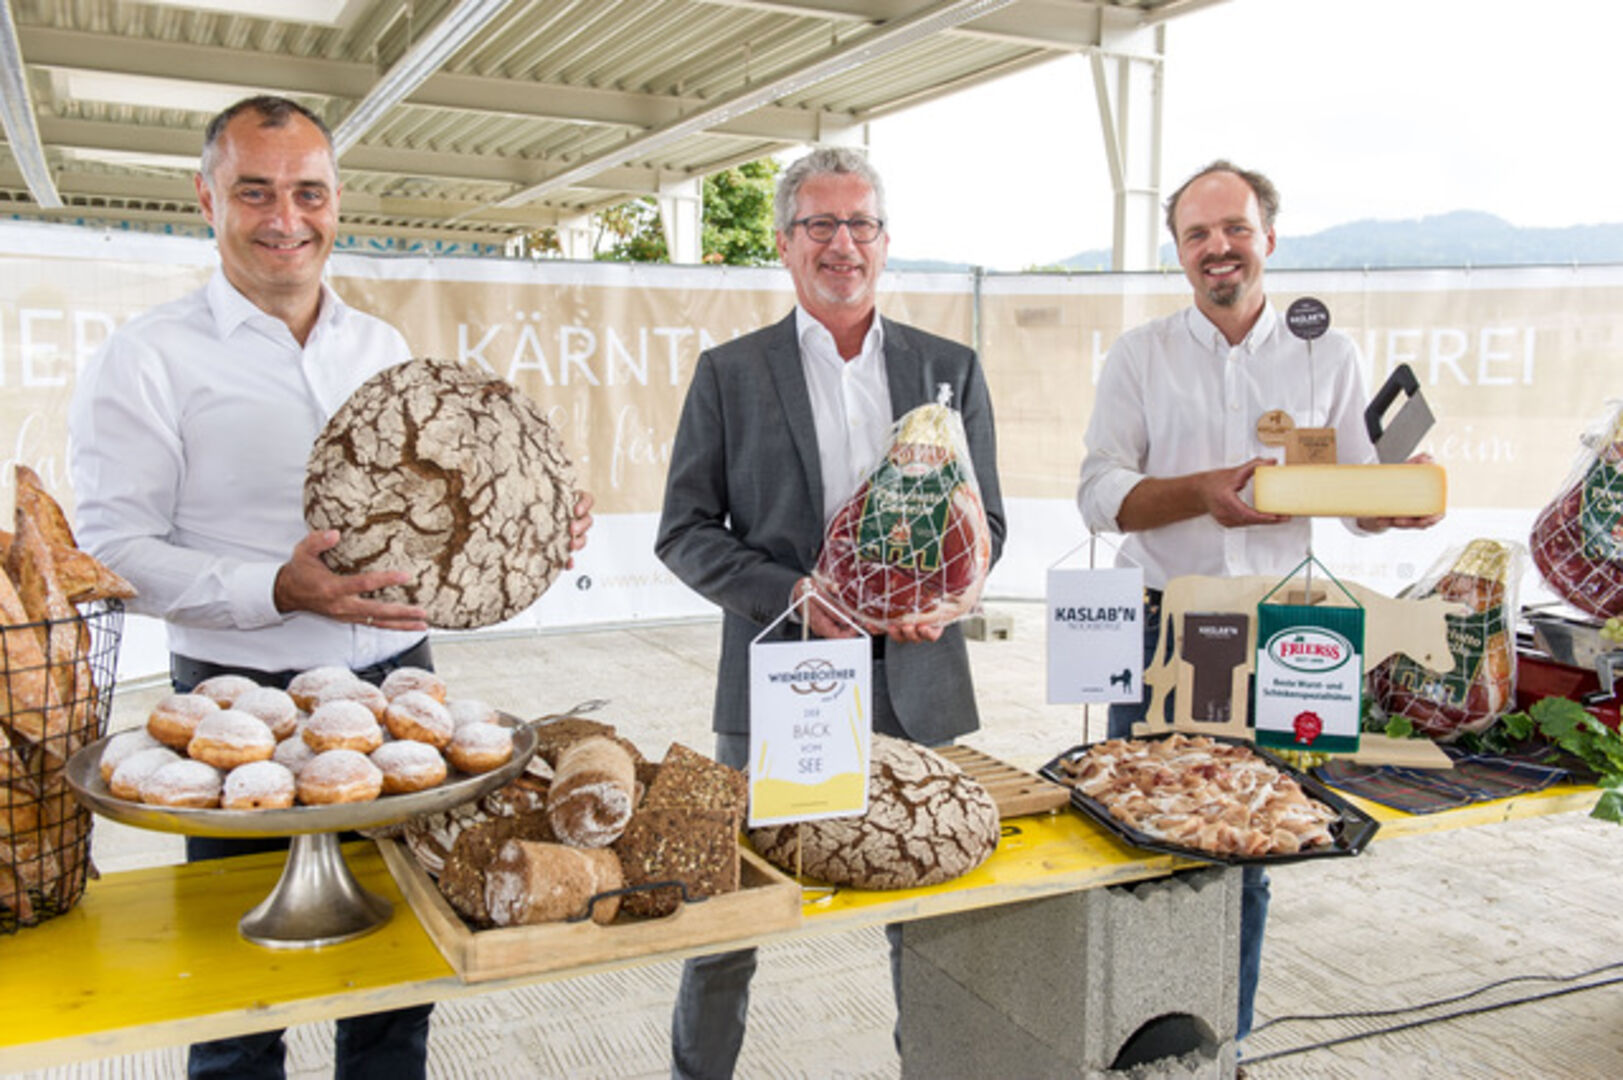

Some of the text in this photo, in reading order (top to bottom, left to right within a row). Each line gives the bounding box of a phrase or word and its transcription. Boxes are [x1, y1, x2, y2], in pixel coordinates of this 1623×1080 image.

[1055, 606, 1136, 622] KASLAB'N
[1280, 642, 1340, 660] FRIERSS
[798, 757, 824, 774] SEE
